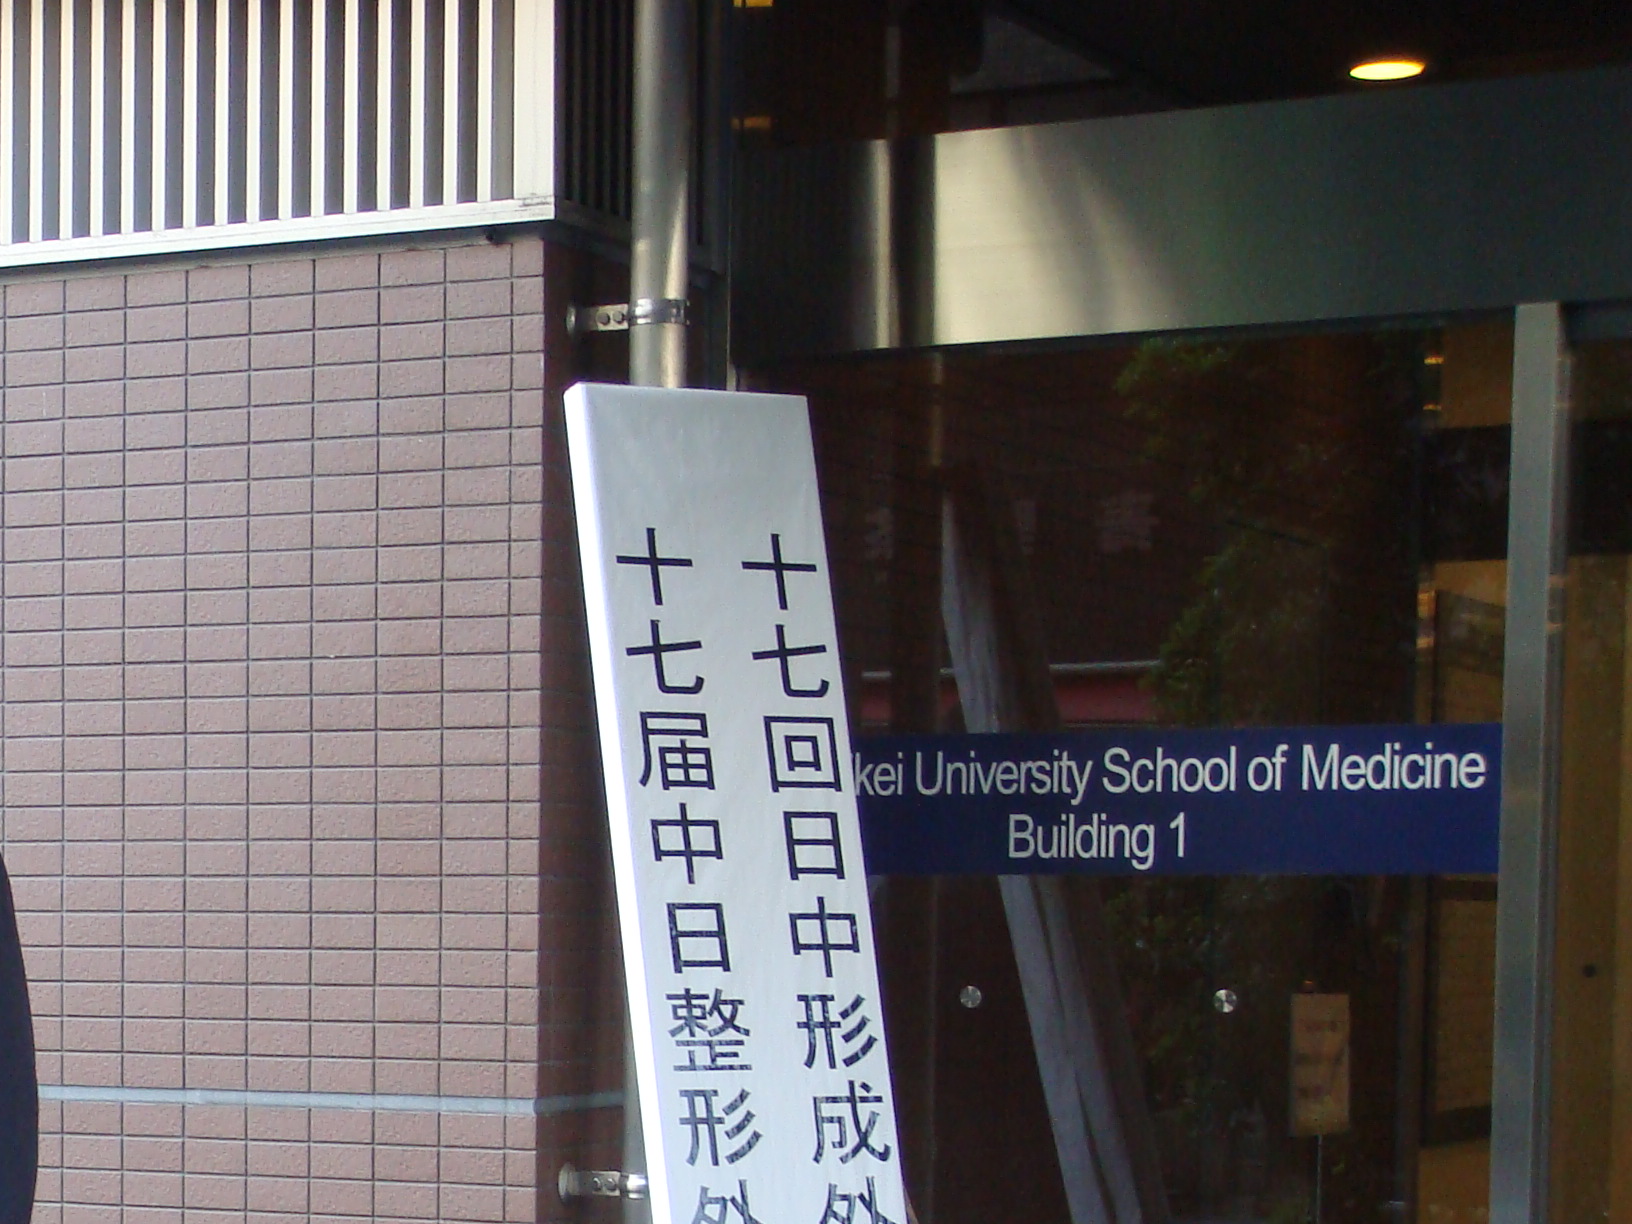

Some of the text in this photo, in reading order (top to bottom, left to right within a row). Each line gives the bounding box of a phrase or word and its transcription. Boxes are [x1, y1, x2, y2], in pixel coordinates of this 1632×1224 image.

[853, 741, 1487, 805] kei University School of Medicine
[1008, 811, 1186, 870] Building 1
